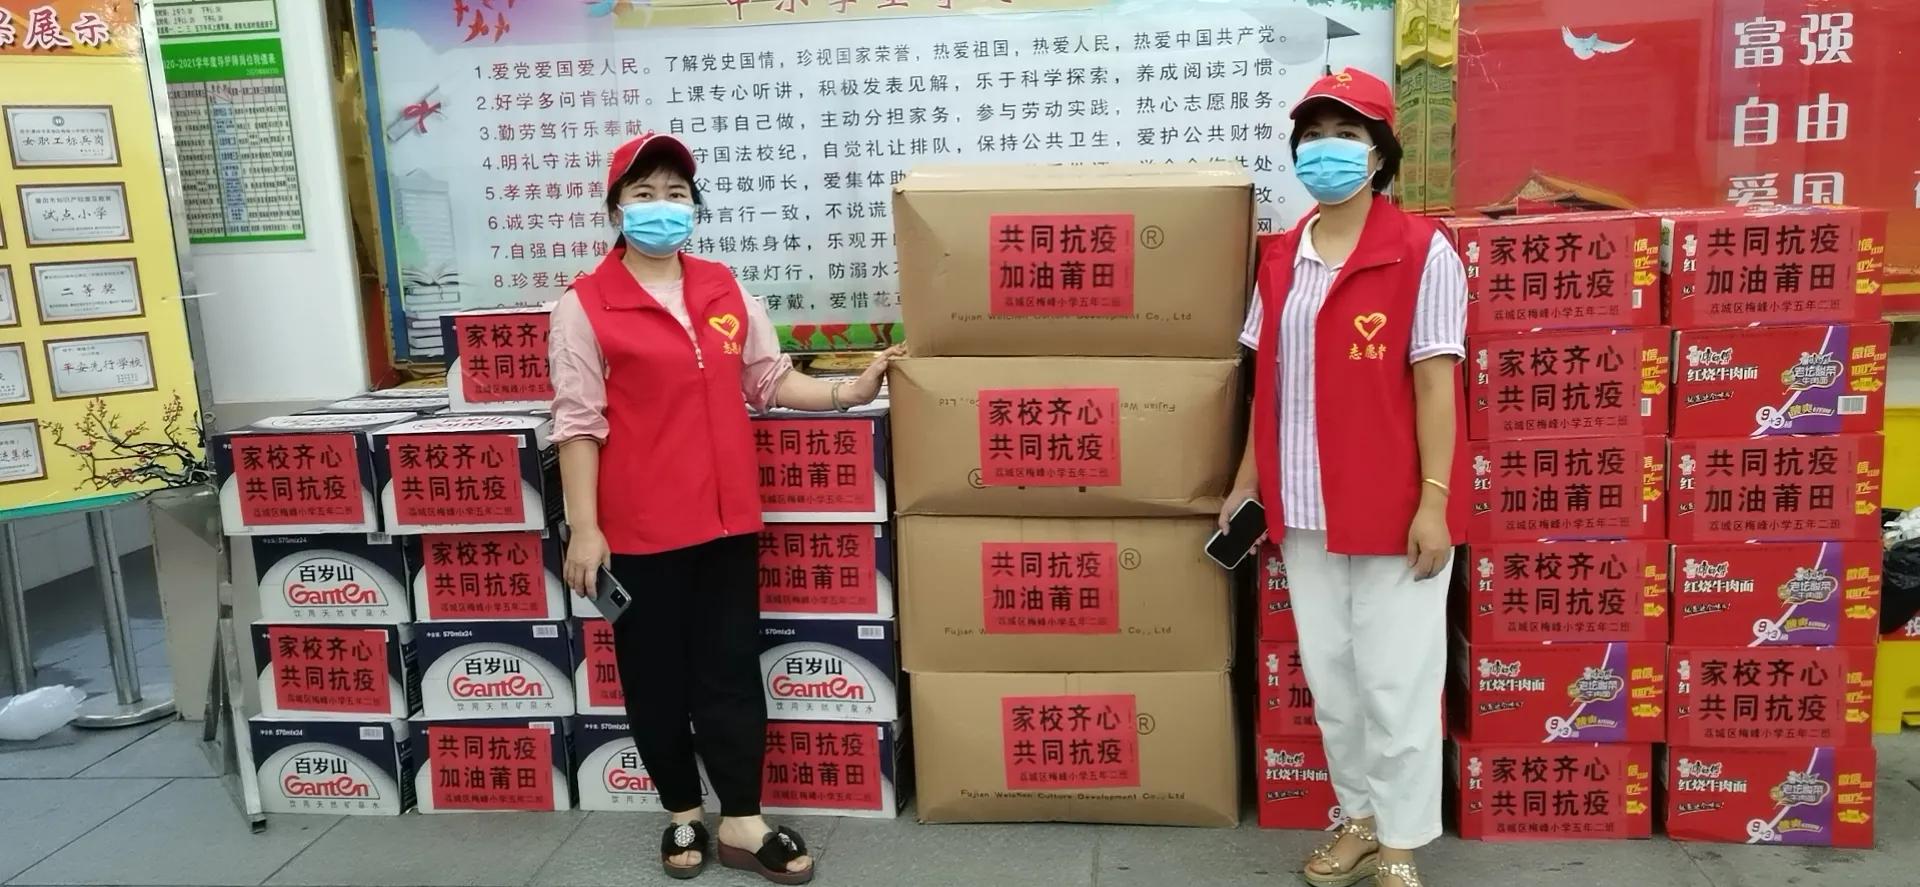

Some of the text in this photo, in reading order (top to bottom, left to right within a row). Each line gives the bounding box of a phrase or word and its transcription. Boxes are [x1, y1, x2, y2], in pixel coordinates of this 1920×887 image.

[1735, 13, 1853, 68] 富强
[1734, 93, 1848, 147] 自由
[42, 206, 107, 222] 试点小学
[61, 282, 116, 297] 二等奖
[1687, 367, 1758, 382] 红烧牛肉面
[299, 564, 354, 582] 百岁山
[1684, 579, 1754, 593] 红烧牛肉面
[464, 657, 521, 675] 百岁山
[785, 657, 843, 675] 百岁山
[295, 757, 349, 775] 百岁山
[1678, 779, 1747, 793] 红烧牛肉面
